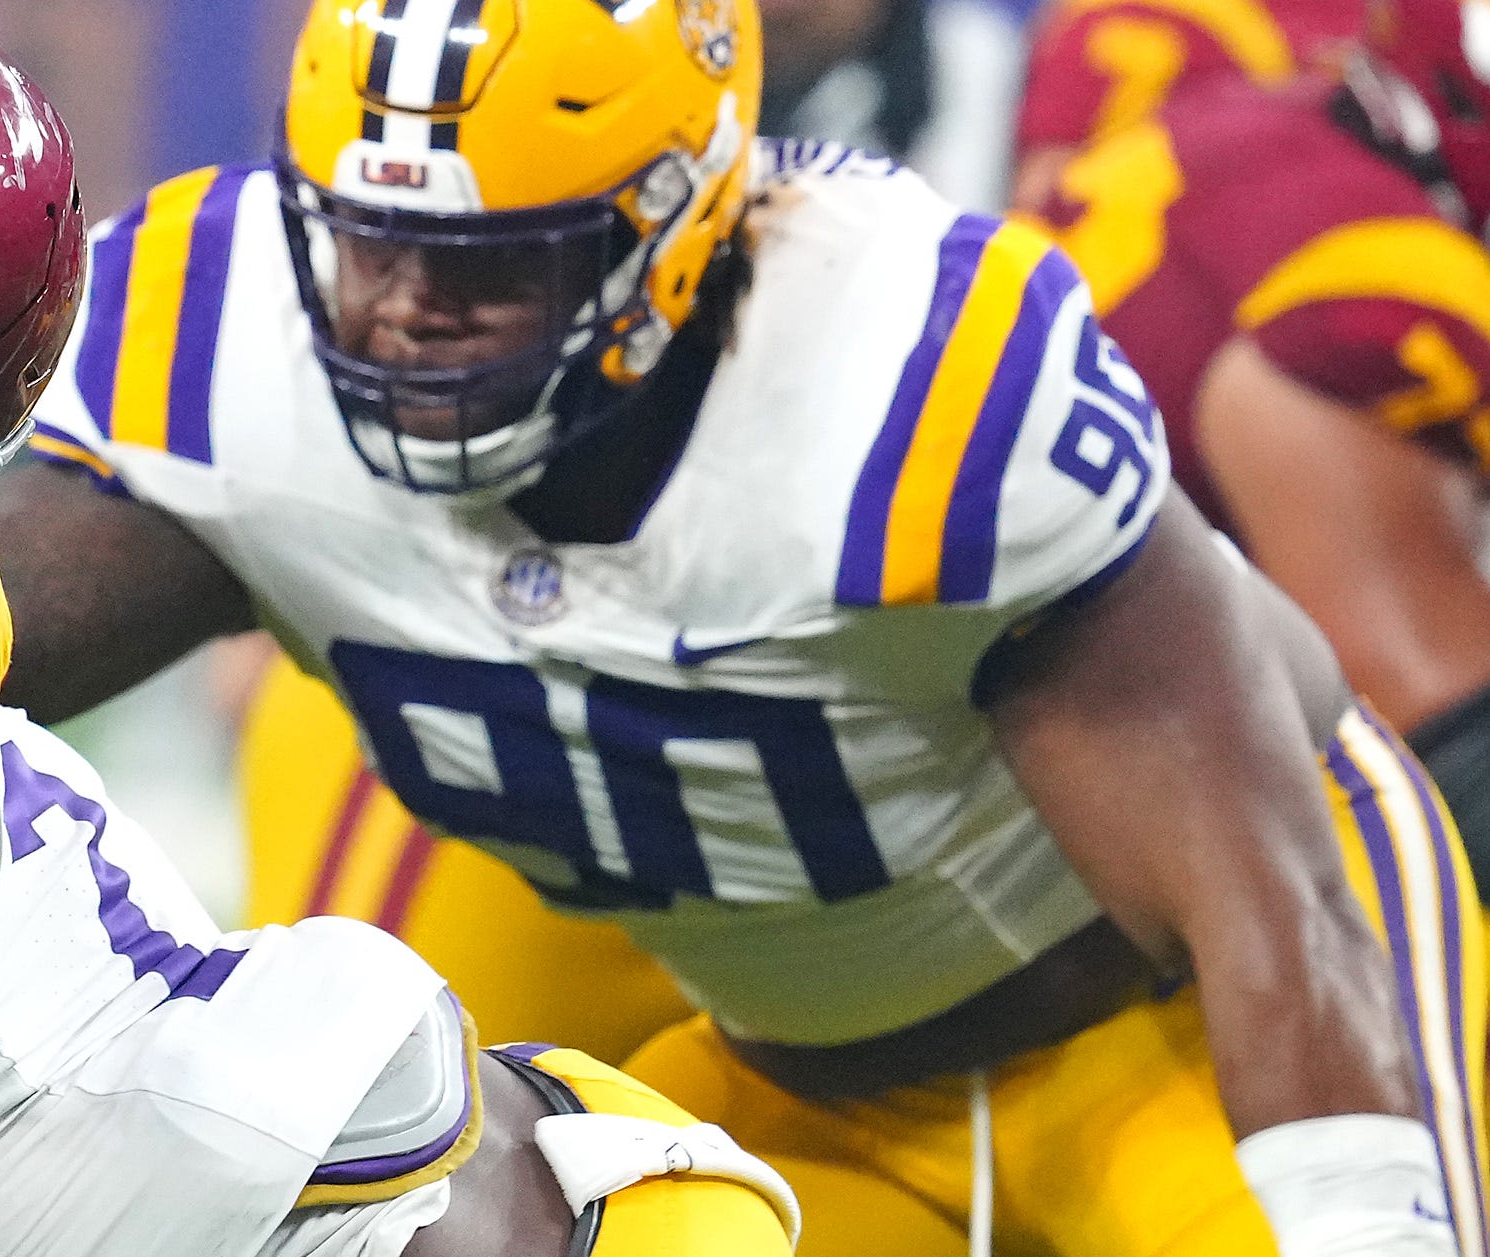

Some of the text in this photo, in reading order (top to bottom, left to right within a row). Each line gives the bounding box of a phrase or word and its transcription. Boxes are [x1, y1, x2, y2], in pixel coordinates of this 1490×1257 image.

[361, 158, 427, 188] LSU
[1049, 314, 1157, 529] 90
[329, 639, 893, 911] 90
